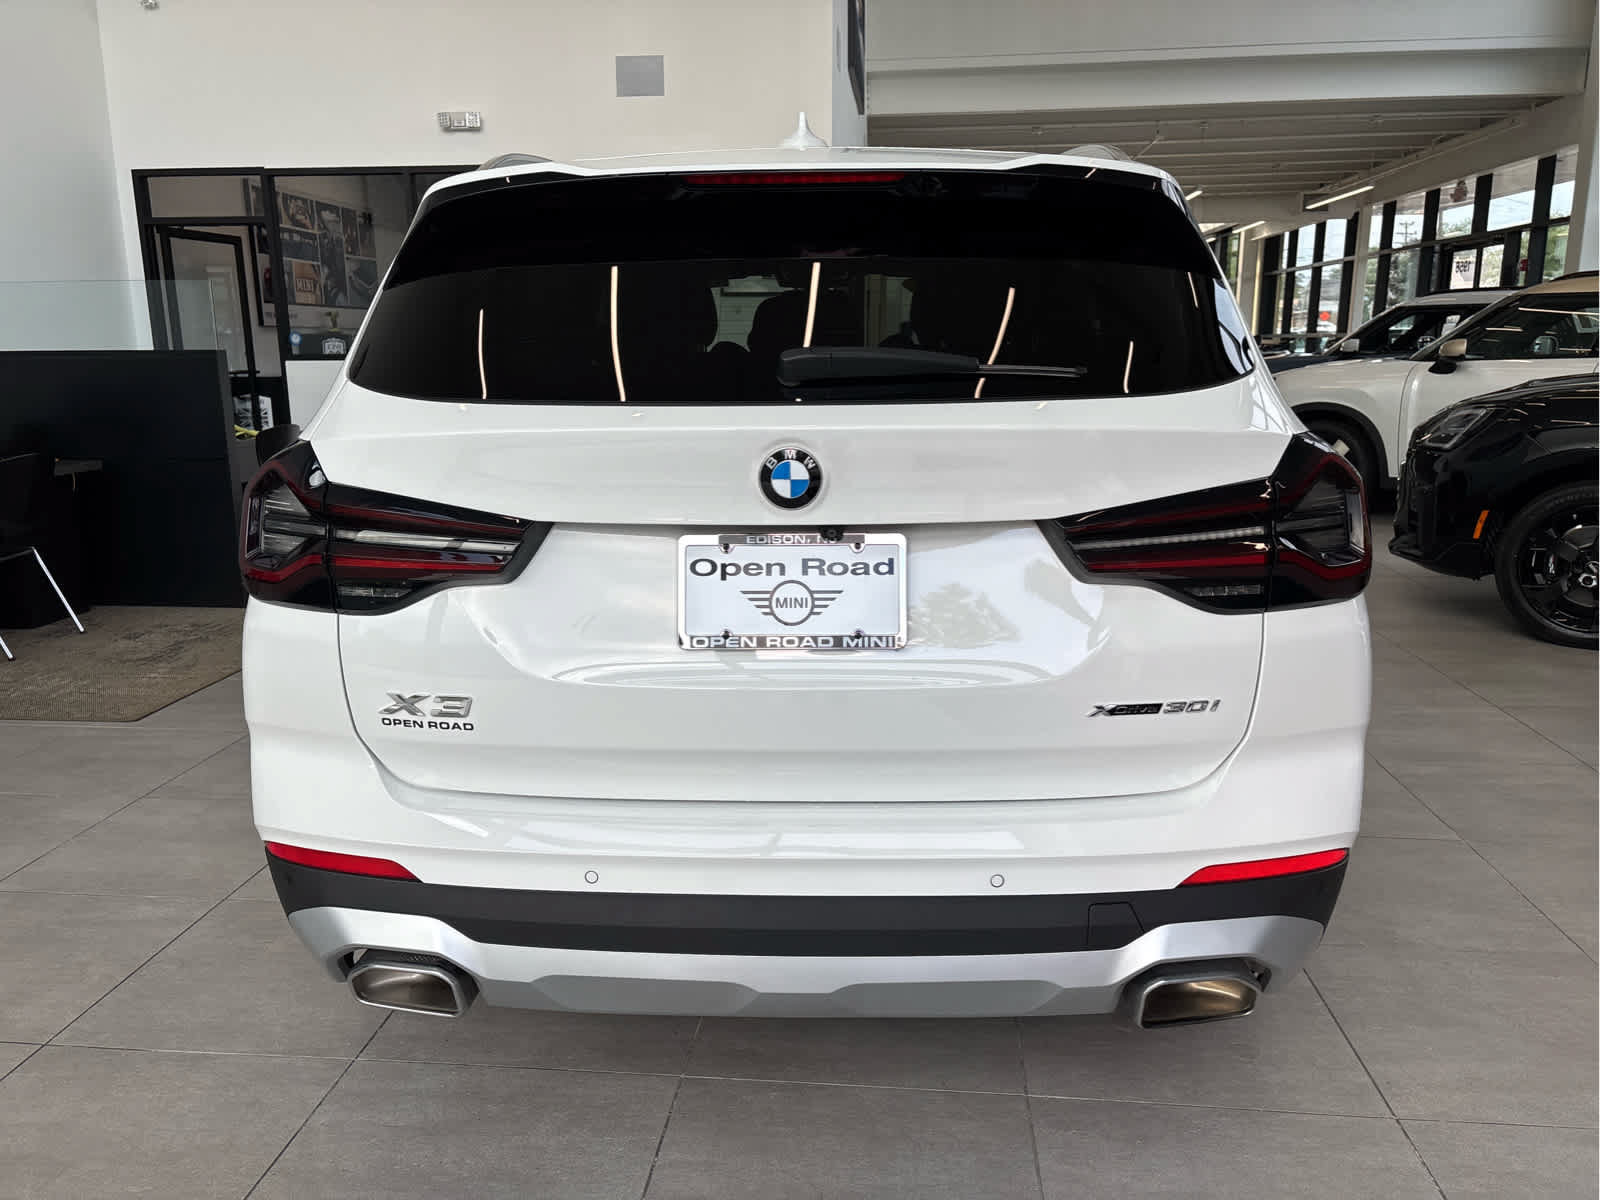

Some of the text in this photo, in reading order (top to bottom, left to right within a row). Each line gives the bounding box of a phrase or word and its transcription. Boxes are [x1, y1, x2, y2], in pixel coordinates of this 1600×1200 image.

[765, 449, 816, 470] BMW
[746, 535, 811, 545] EDISON,
[689, 557, 895, 581] Open Road
[775, 597, 809, 609] MINI
[692, 636, 893, 649] OPEN ROAD MINI
[378, 693, 473, 718] X3
[381, 717, 474, 731] OPEN ROAD
